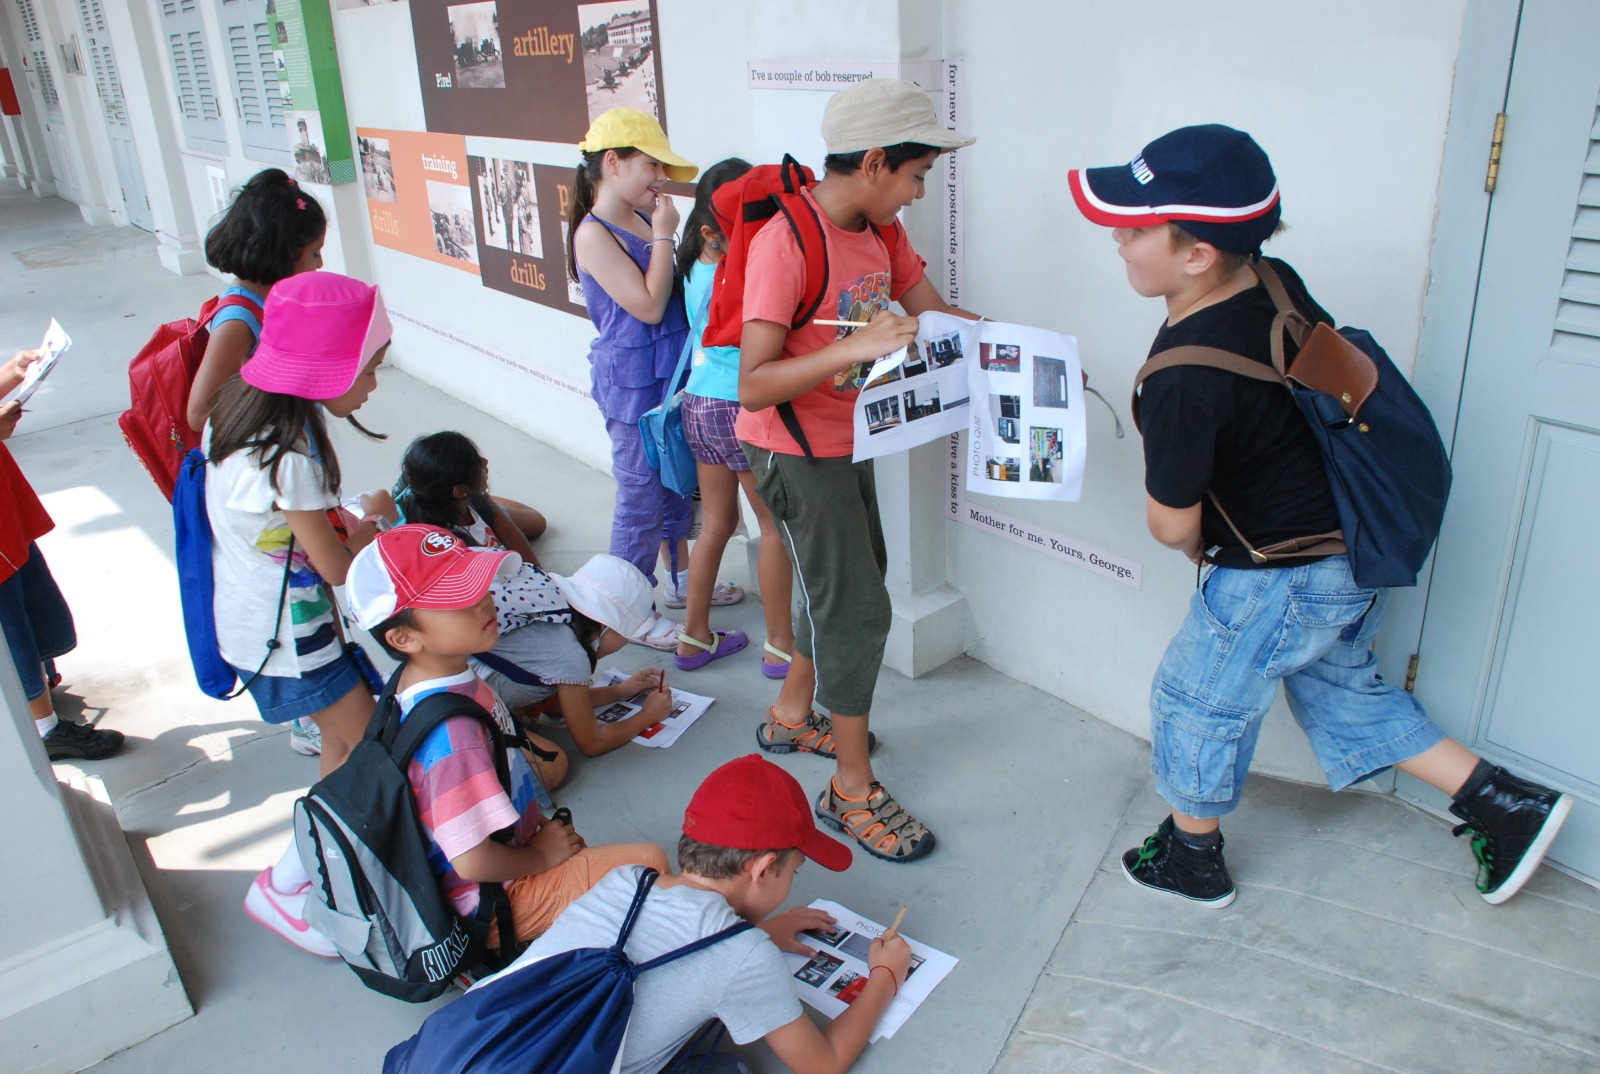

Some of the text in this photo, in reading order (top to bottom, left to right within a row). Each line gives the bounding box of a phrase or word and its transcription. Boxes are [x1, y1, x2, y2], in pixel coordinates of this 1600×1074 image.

[513, 27, 575, 64] artillery
[435, 73, 452, 88] Fire!
[751, 69, 766, 81] I've
[767, 73, 773, 81] a
[774, 70, 802, 84] couple
[804, 70, 814, 82] of
[815, 70, 831, 82] bob
[949, 63, 957, 87] for
[421, 153, 458, 179] training
[1131, 153, 1155, 185] LAND
[372, 208, 399, 236] drills
[947, 183, 958, 255] postcards
[510, 259, 546, 291] drills
[948, 258, 959, 300] you'll
[950, 431, 959, 459] Give
[972, 416, 982, 477] PHOTO QUIZ
[950, 473, 959, 499] kiss
[950, 501, 958, 514] to
[969, 508, 1135, 580] Mother for me. Yours, George.
[421, 916, 470, 983] NIKE
